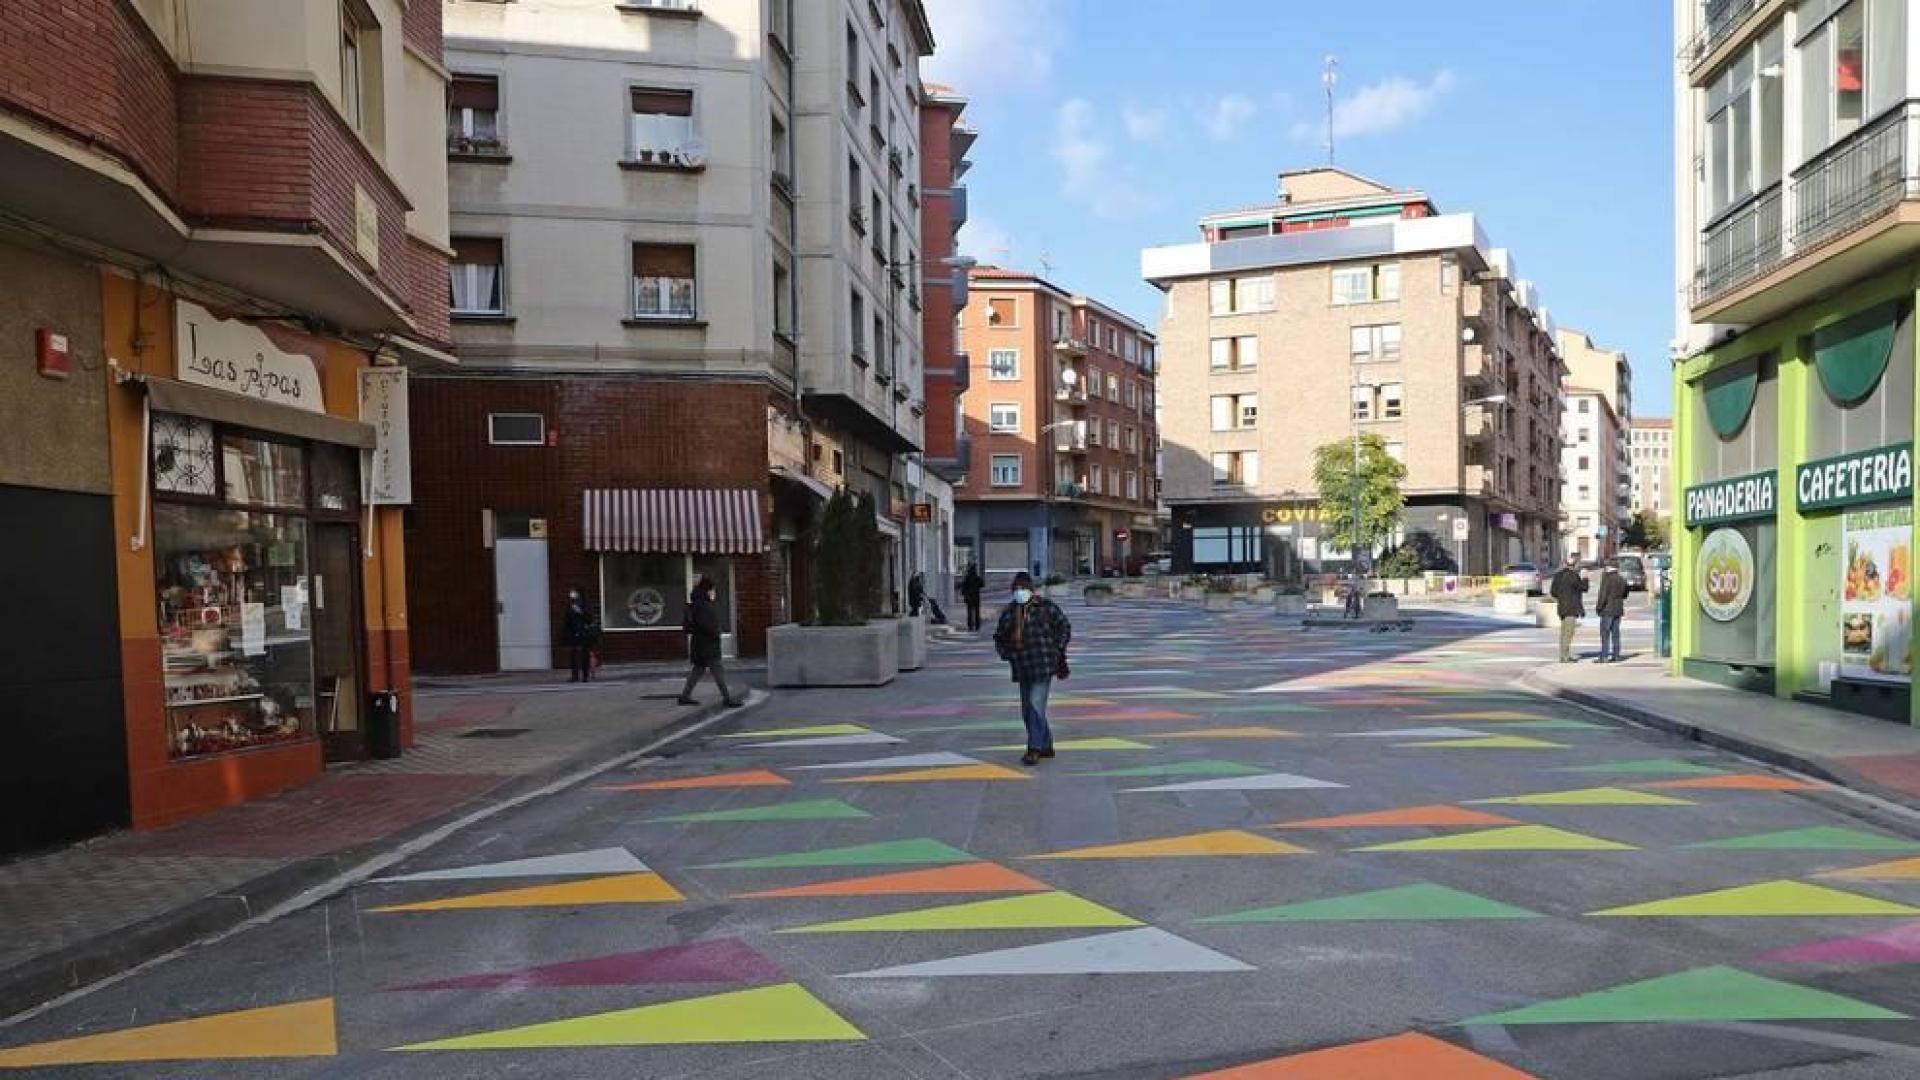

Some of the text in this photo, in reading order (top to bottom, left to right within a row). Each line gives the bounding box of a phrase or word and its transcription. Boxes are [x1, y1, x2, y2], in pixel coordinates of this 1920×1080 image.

[186, 322, 237, 381] Las
[1687, 476, 1774, 521] PANADERIA
[1799, 449, 1911, 504] CAFETERIA
